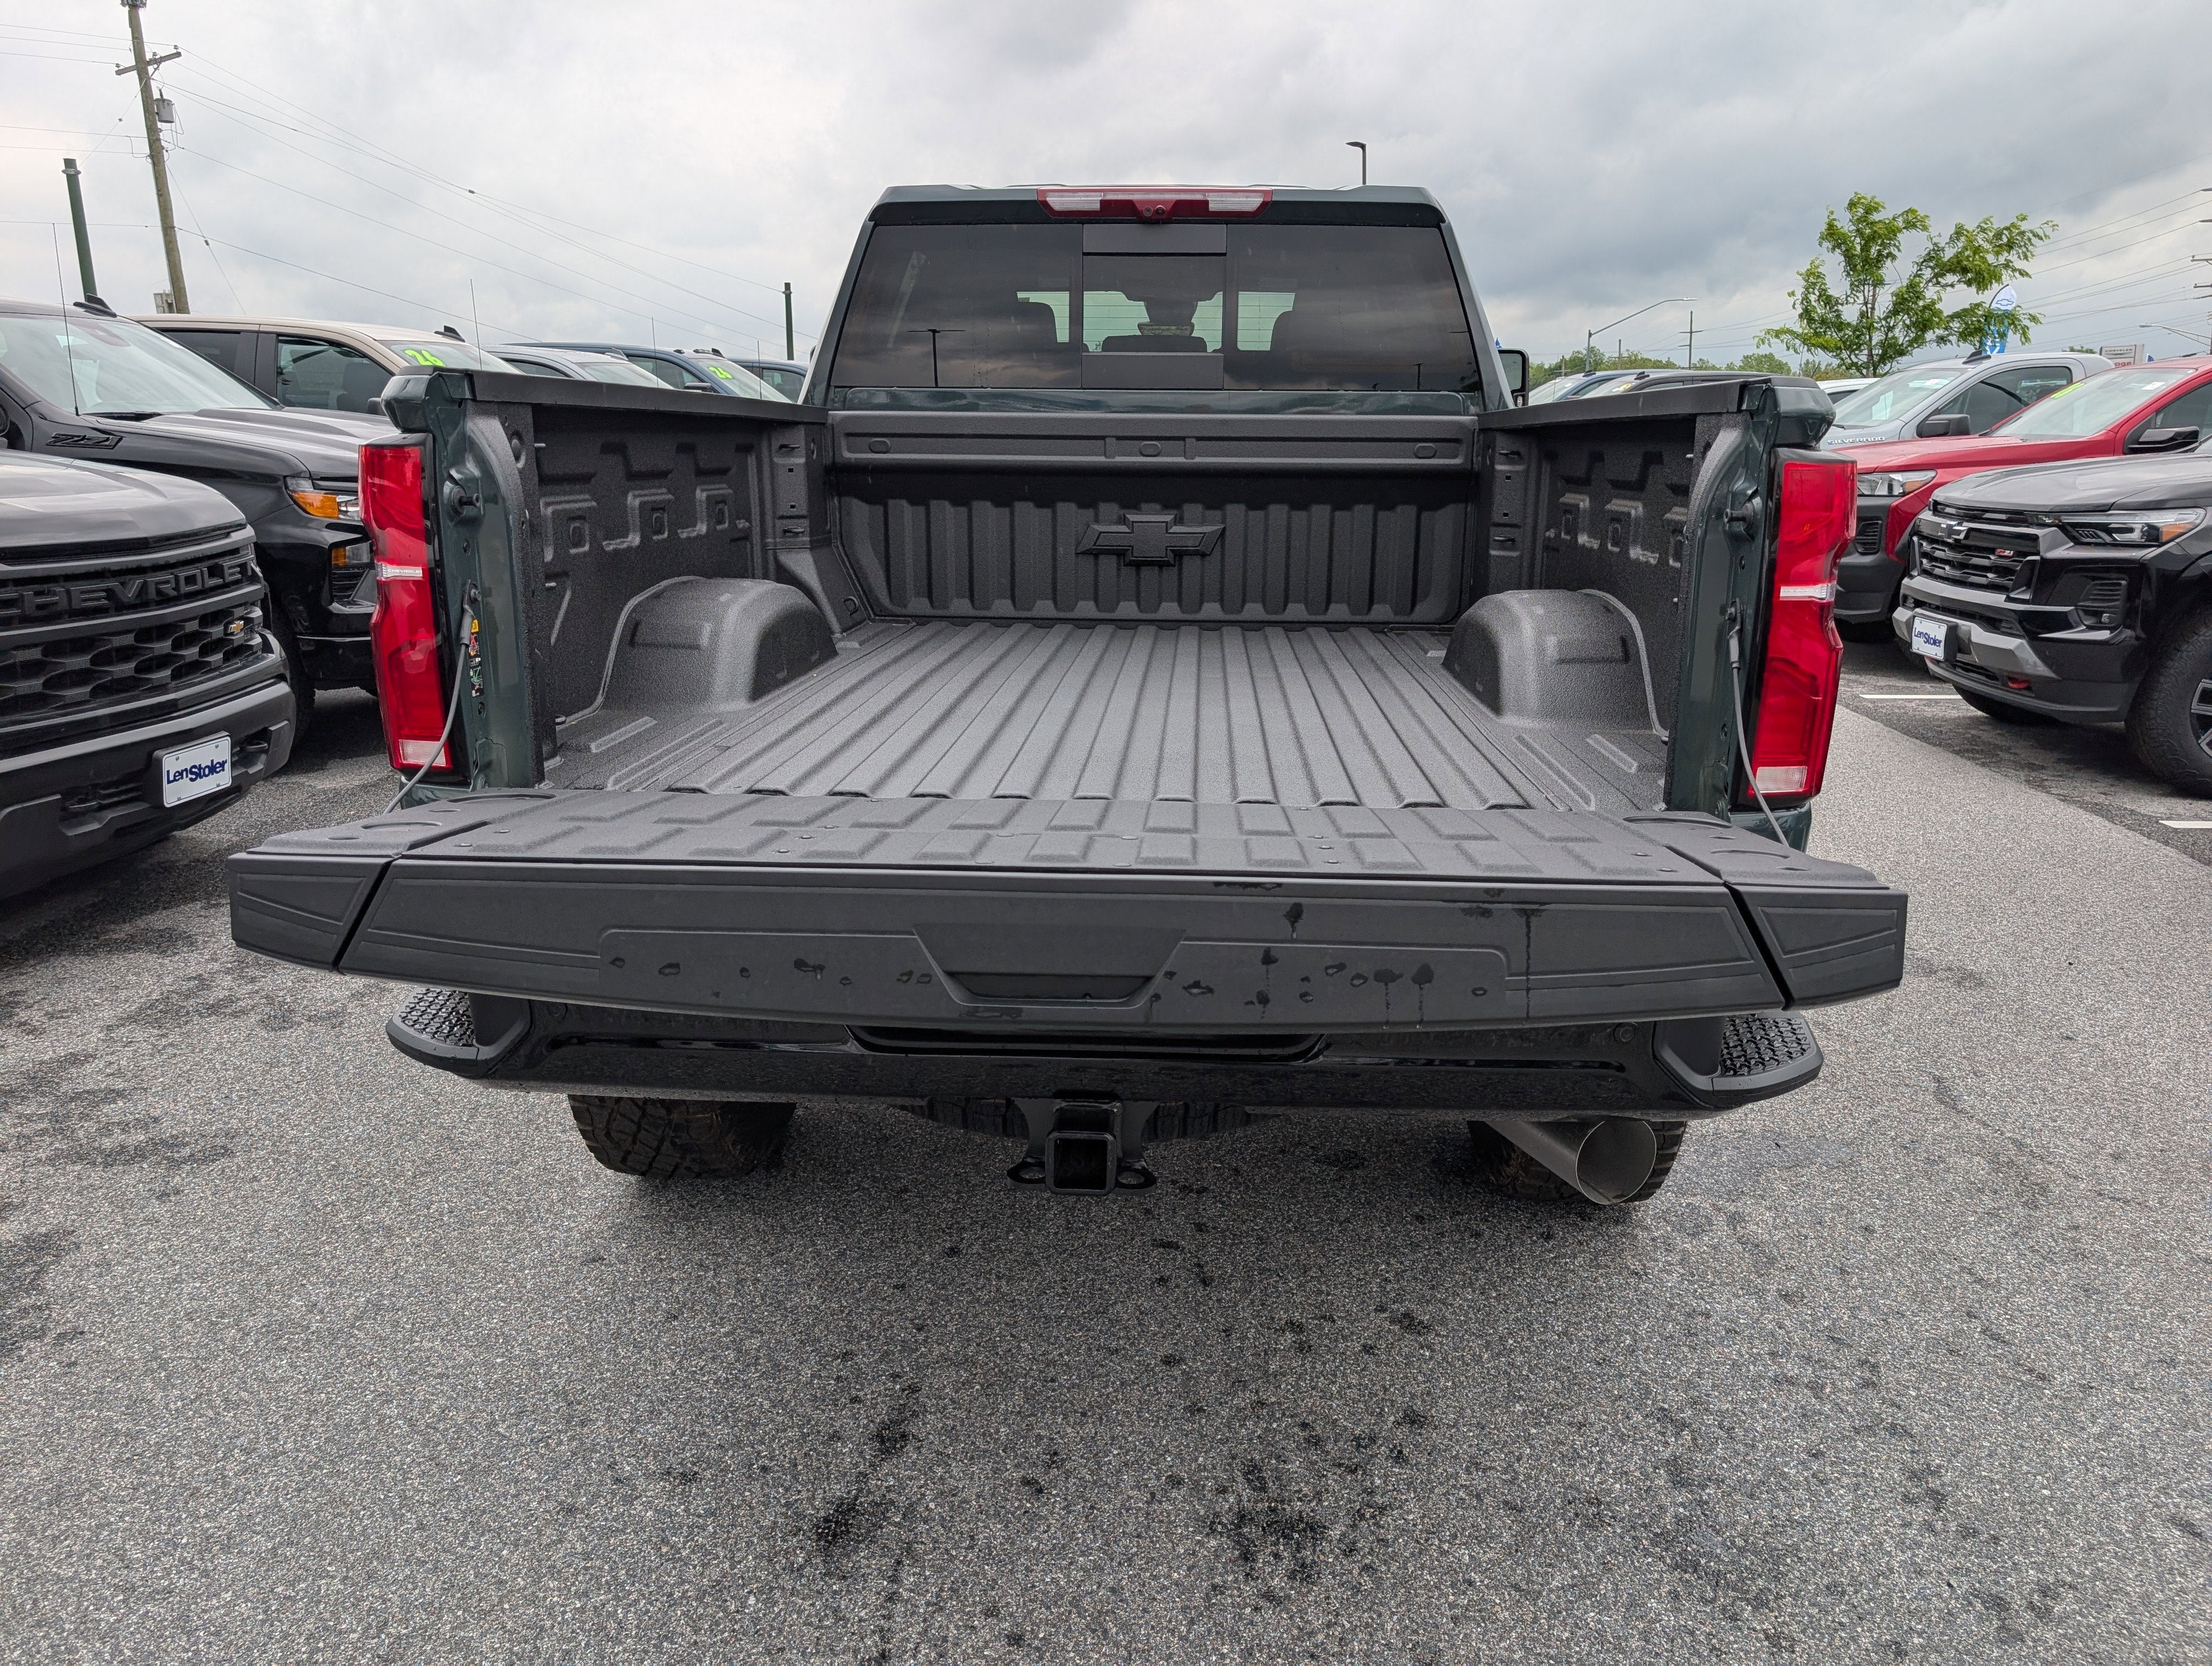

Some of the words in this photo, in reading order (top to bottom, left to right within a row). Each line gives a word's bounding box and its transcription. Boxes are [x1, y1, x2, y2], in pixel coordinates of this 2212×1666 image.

[404, 349, 446, 367] 26
[709, 367, 732, 379] 26
[46, 433, 123, 450] Z71
[1828, 437, 1885, 445] SILVERADO
